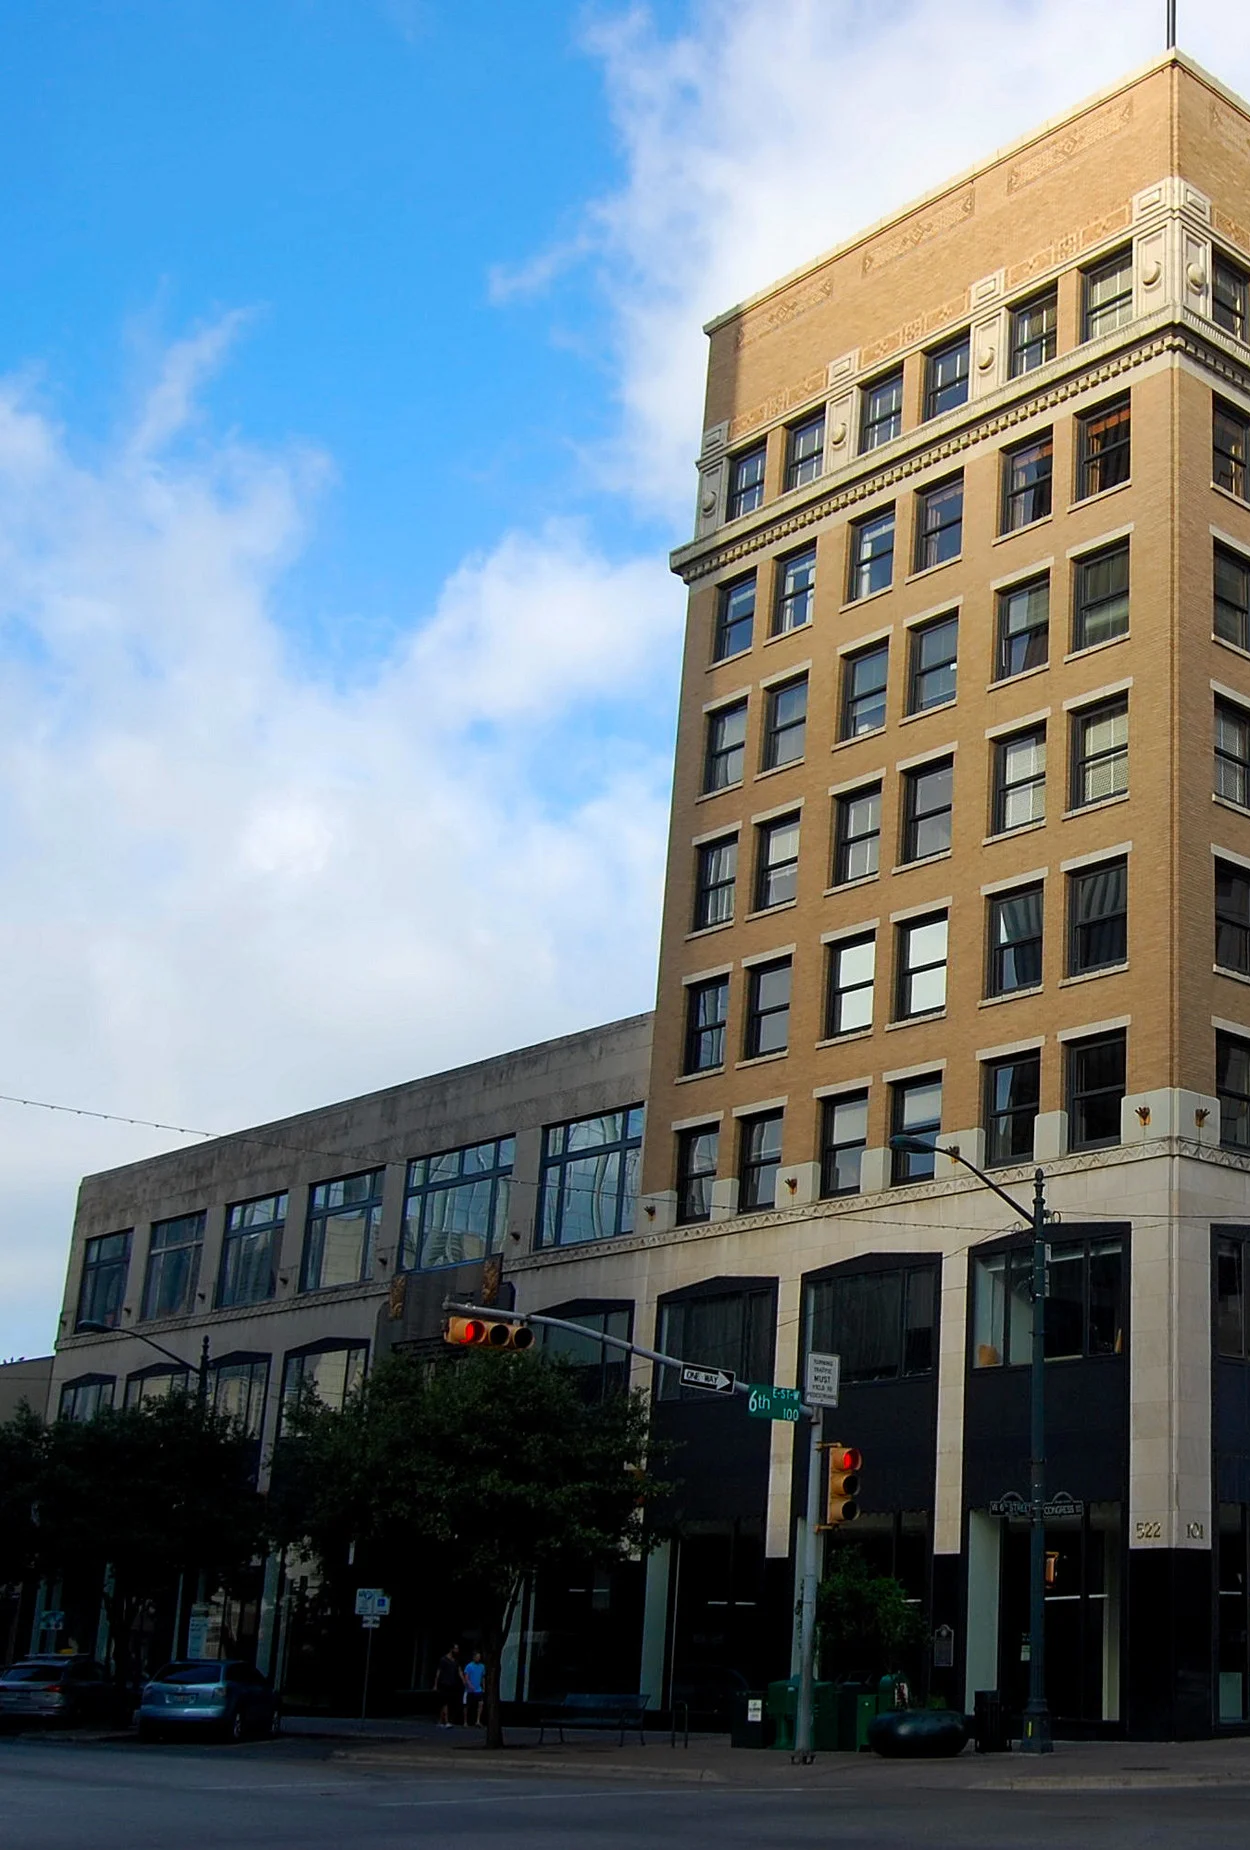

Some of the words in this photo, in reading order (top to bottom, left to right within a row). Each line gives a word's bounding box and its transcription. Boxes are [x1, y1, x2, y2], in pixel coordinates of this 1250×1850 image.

[686, 1370, 700, 1381] ONE
[704, 1373, 719, 1385] WAY
[814, 1375, 831, 1384] MUST
[748, 1389, 771, 1412] 6th
[783, 1408, 799, 1421] 100
[1136, 1522, 1161, 1539] 522
[1186, 1522, 1204, 1539] 101
